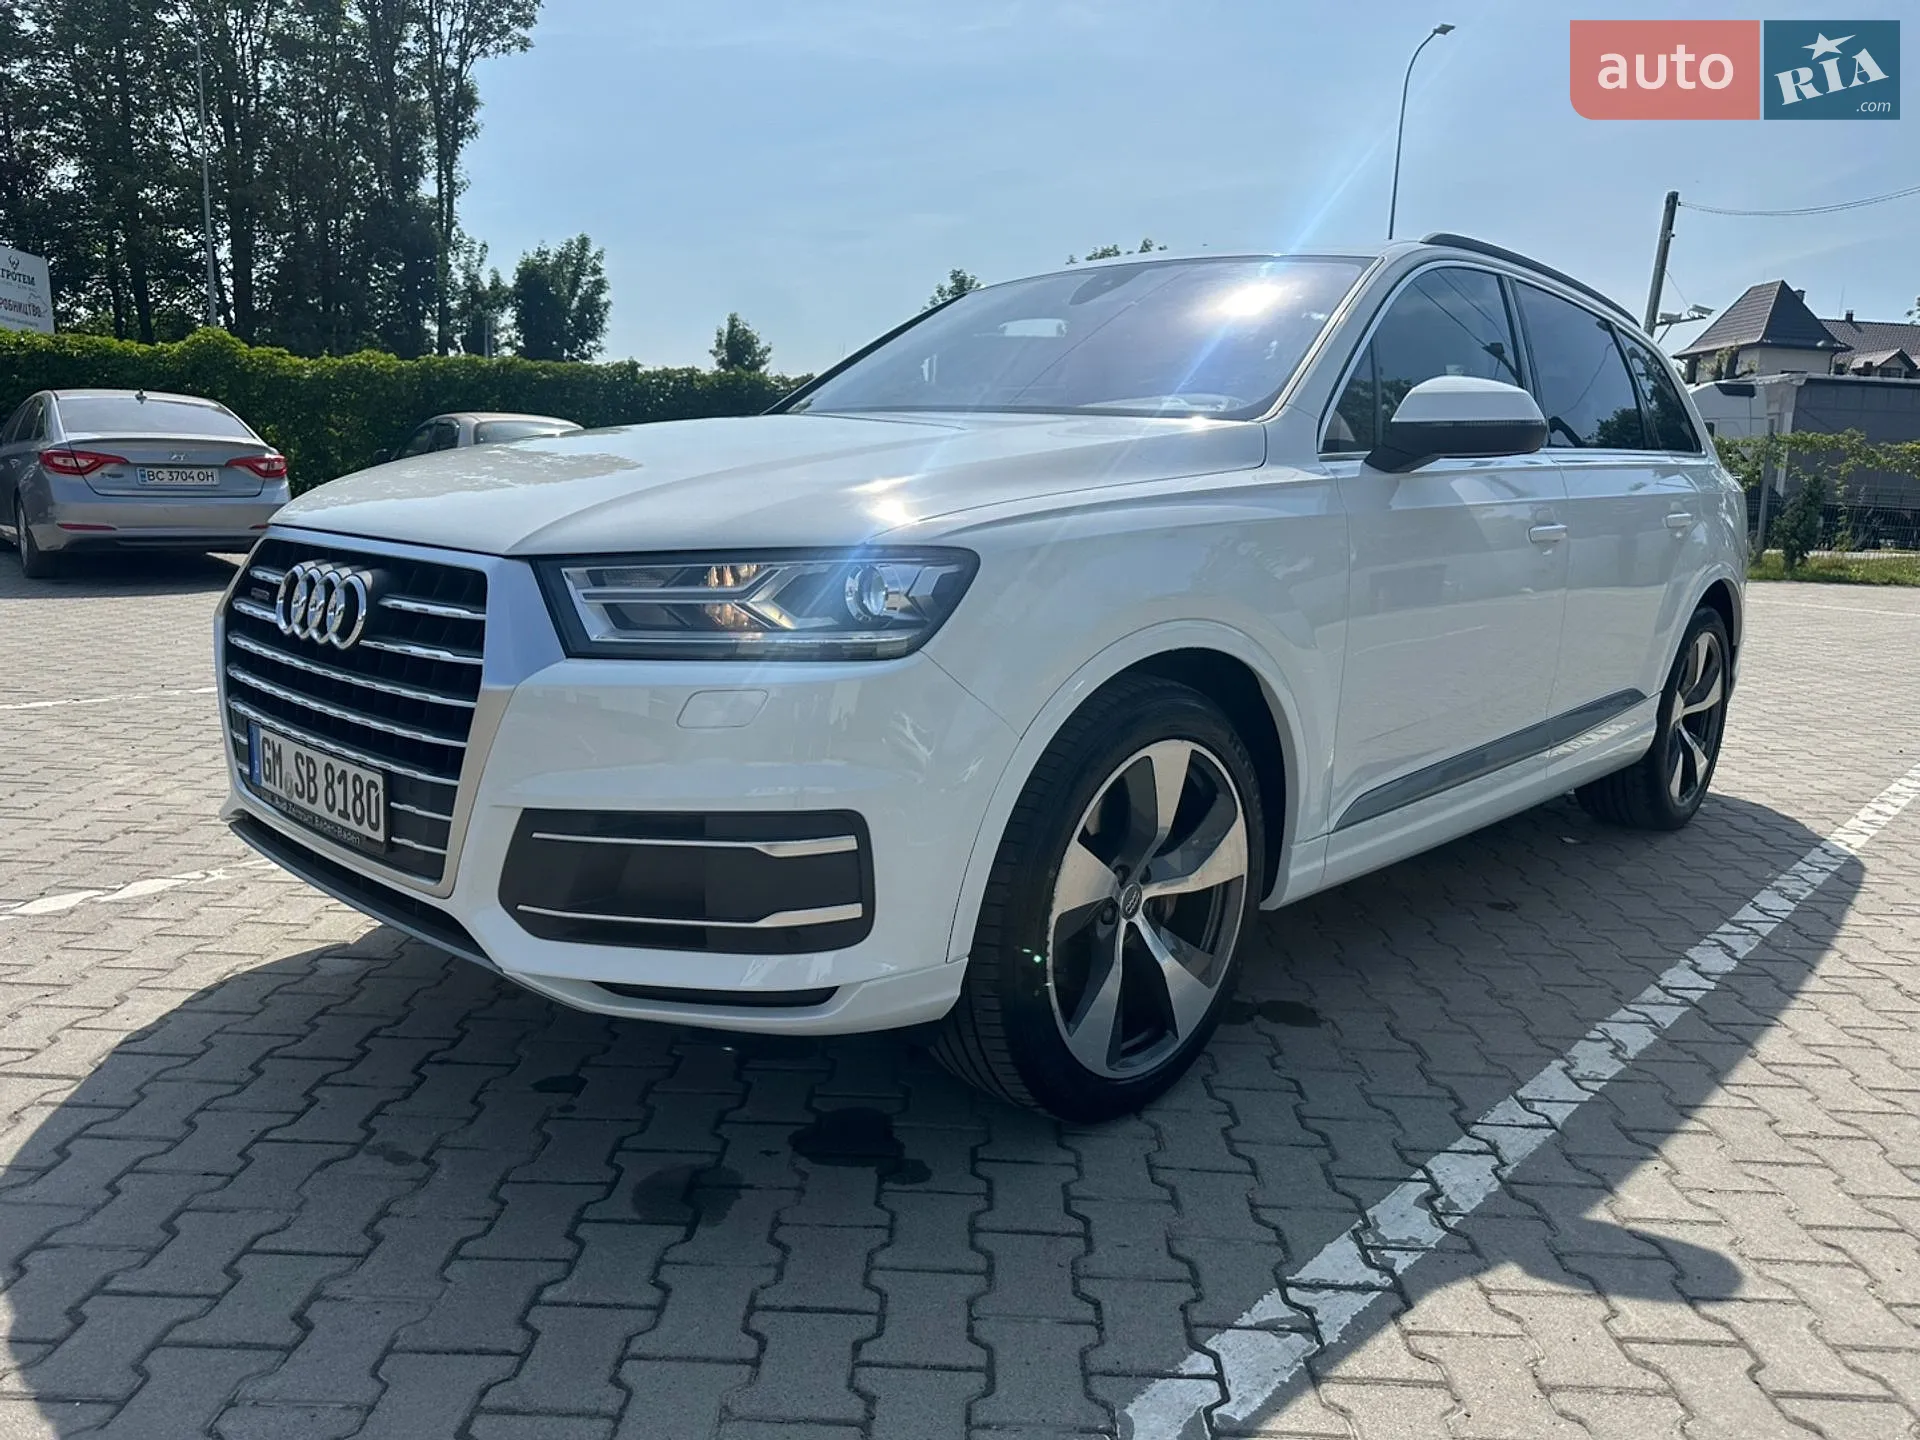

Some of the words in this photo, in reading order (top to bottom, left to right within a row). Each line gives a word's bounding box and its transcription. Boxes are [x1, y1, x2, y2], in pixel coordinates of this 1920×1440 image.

[146, 470, 165, 482] BC
[167, 470, 195, 482] 3704
[197, 470, 215, 482] OH
[261, 736, 283, 789] GM
[293, 751, 318, 806] SB
[324, 762, 380, 832] 8180
